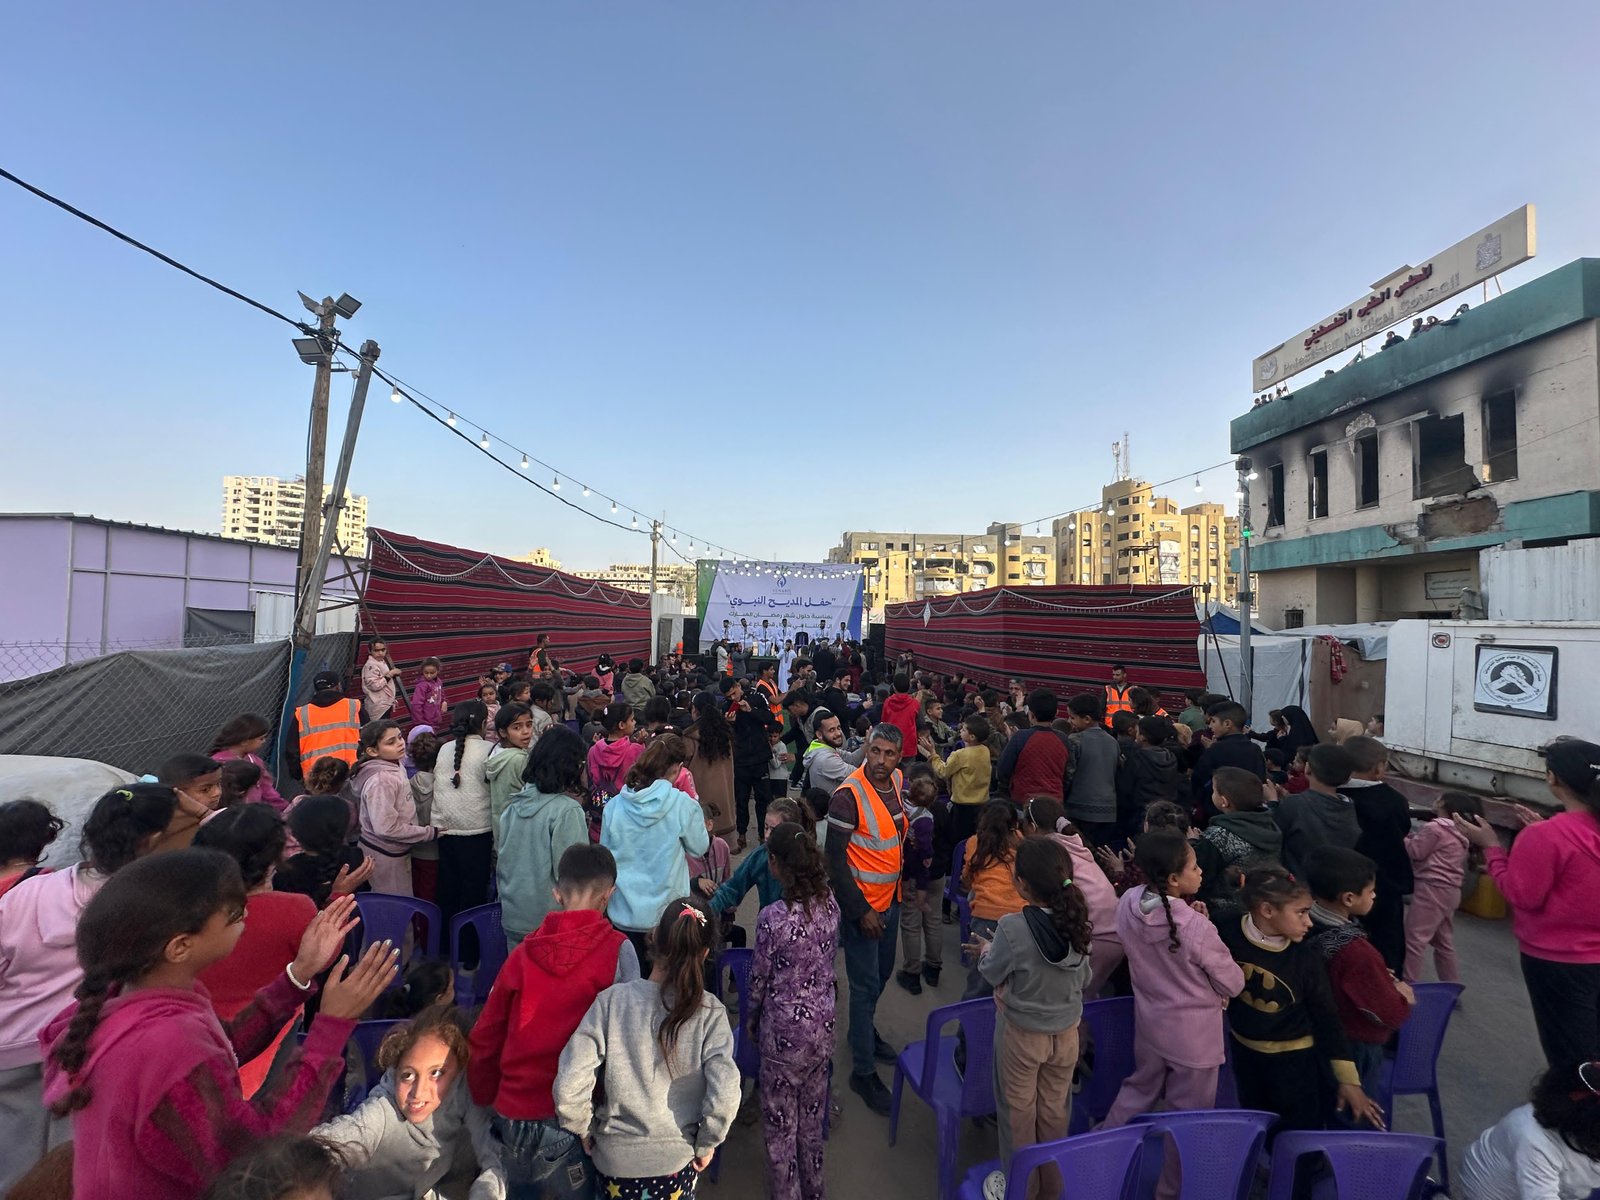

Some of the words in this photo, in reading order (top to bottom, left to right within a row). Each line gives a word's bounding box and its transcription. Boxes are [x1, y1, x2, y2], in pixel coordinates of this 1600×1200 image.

[1357, 287, 1390, 318] الطبي
[1304, 308, 1352, 351] الفلسطيني
[768, 597, 802, 608] المديح
